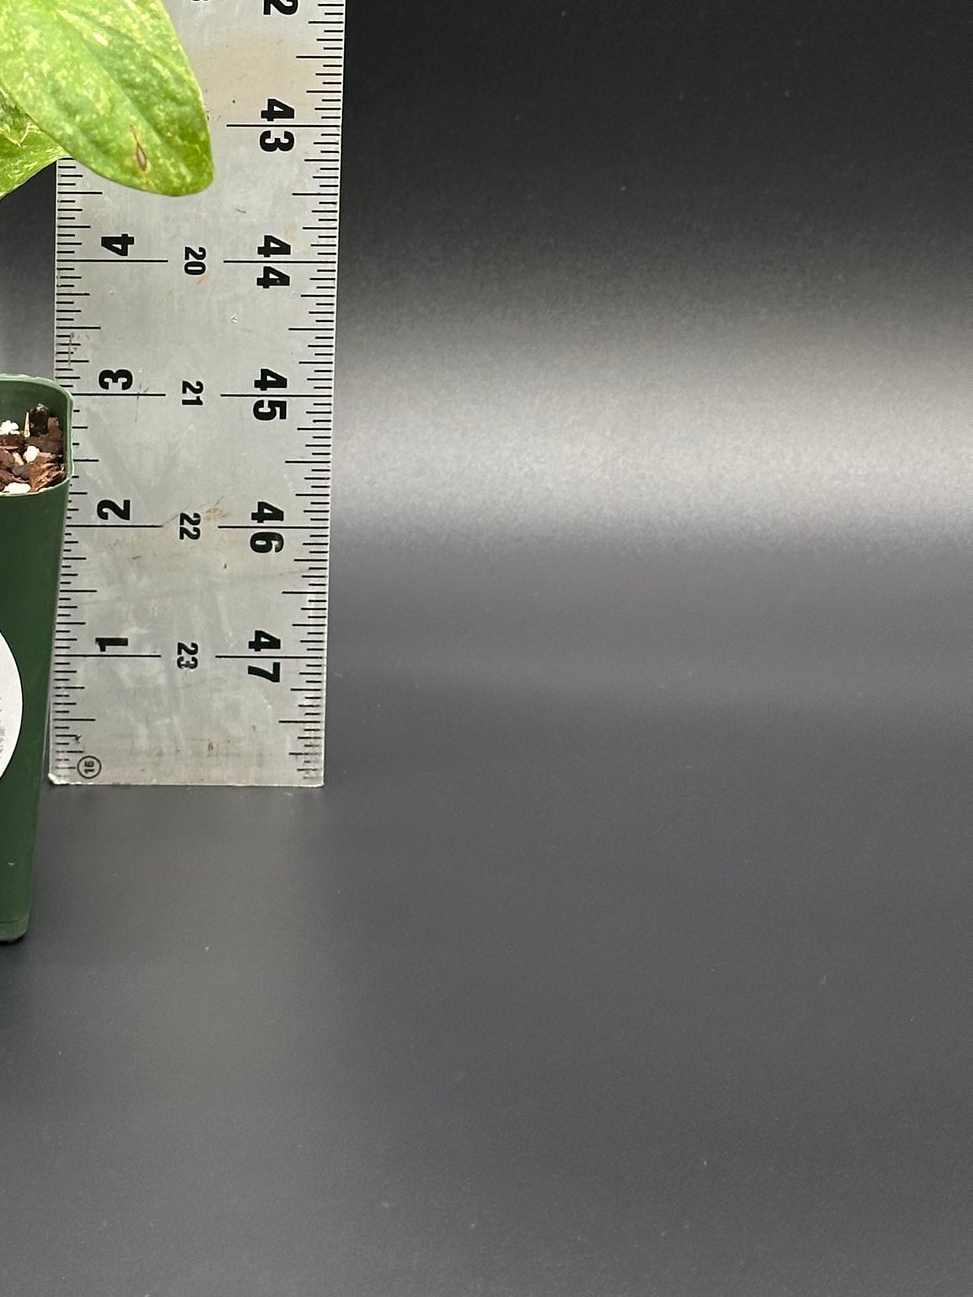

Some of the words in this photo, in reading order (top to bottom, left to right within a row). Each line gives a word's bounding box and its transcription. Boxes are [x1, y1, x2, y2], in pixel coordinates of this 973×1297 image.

[259, 98, 295, 153] 43
[100, 233, 135, 257] 4
[183, 246, 207, 276] 20
[256, 234, 292, 289] 44
[98, 368, 134, 391] 3
[181, 380, 204, 406] 21
[252, 368, 288, 422] 45
[96, 499, 131, 521] 2
[179, 512, 201, 541] 22
[249, 501, 285, 554] 46
[94, 637, 129, 653] 1
[176, 641, 199, 670] 23
[247, 629, 282, 683] 47
